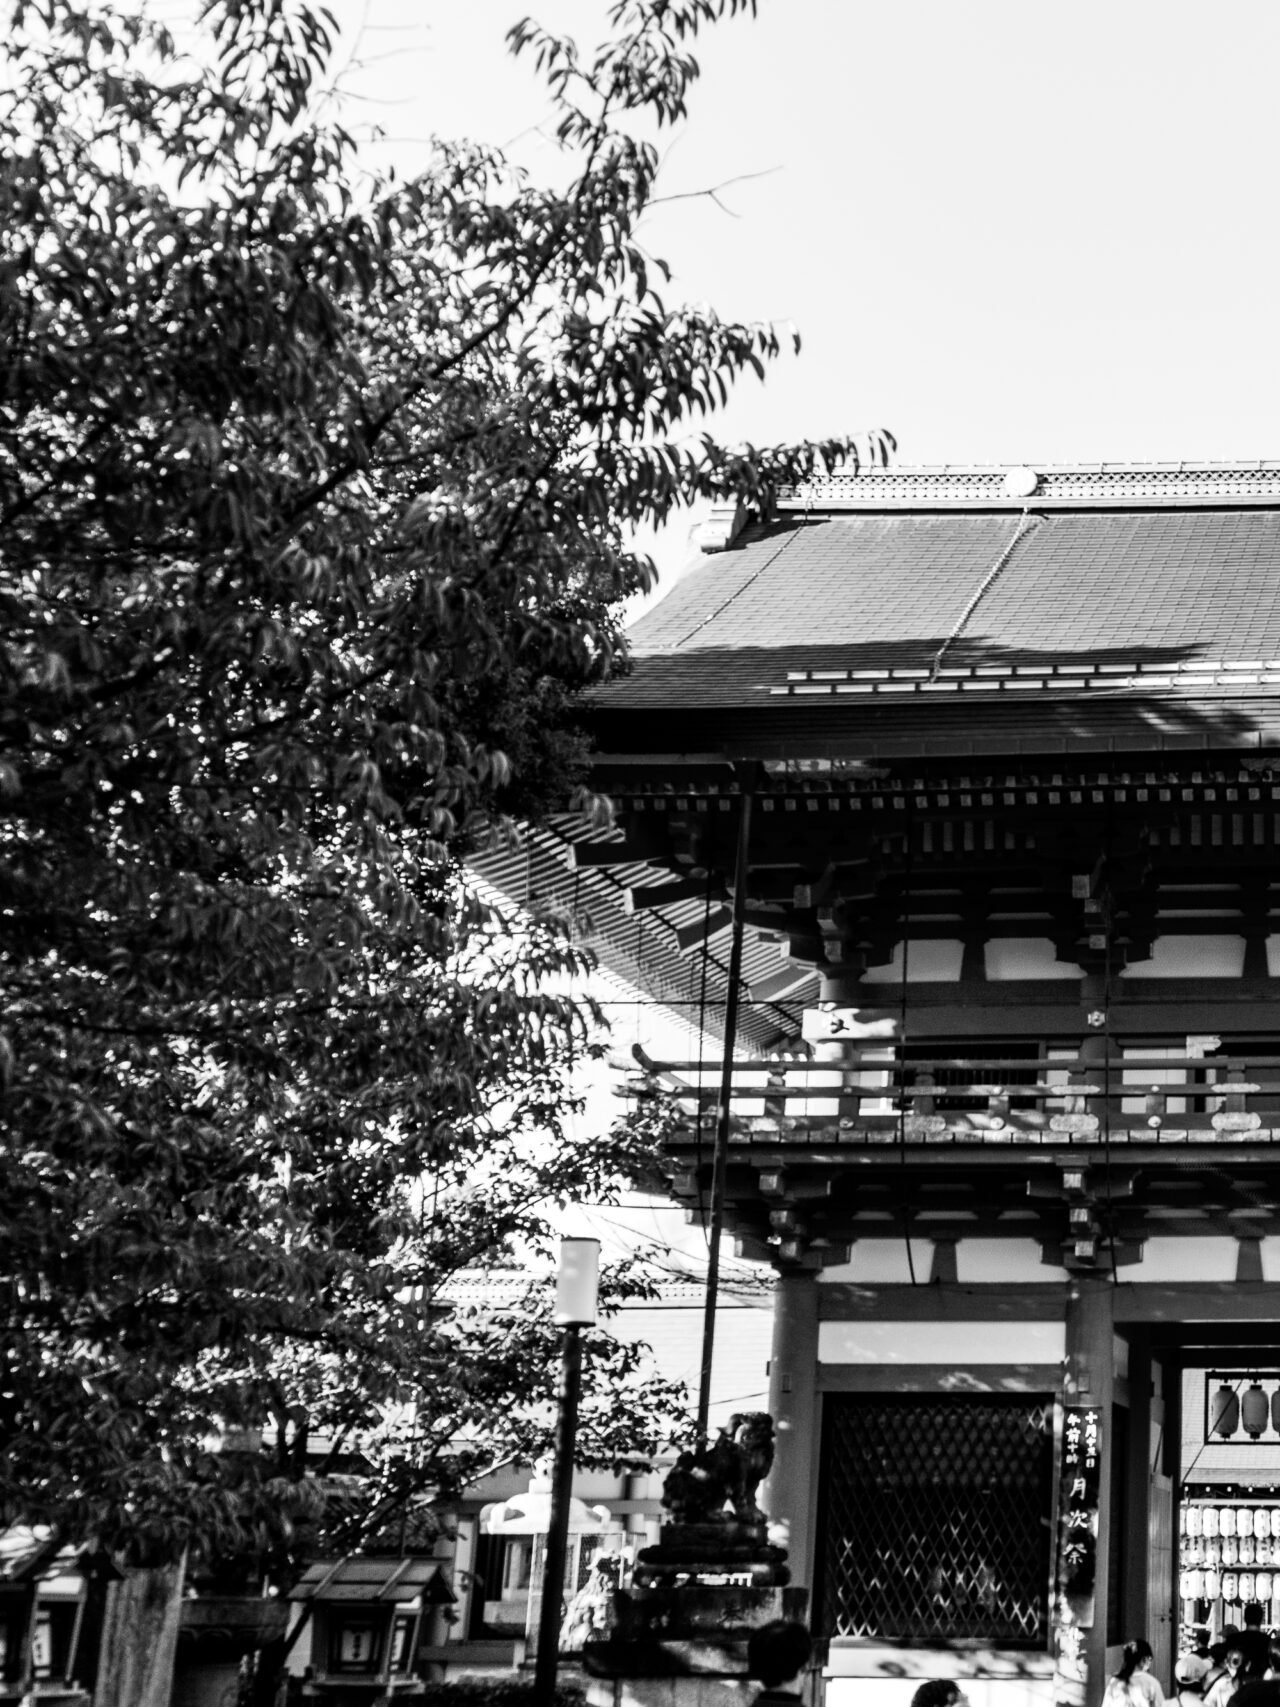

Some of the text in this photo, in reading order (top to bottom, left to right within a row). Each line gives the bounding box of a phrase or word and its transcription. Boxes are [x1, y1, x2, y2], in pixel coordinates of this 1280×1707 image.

[1065, 1413, 1081, 1463] 午前十時
[1062, 1477, 1088, 1564] 月次祭
